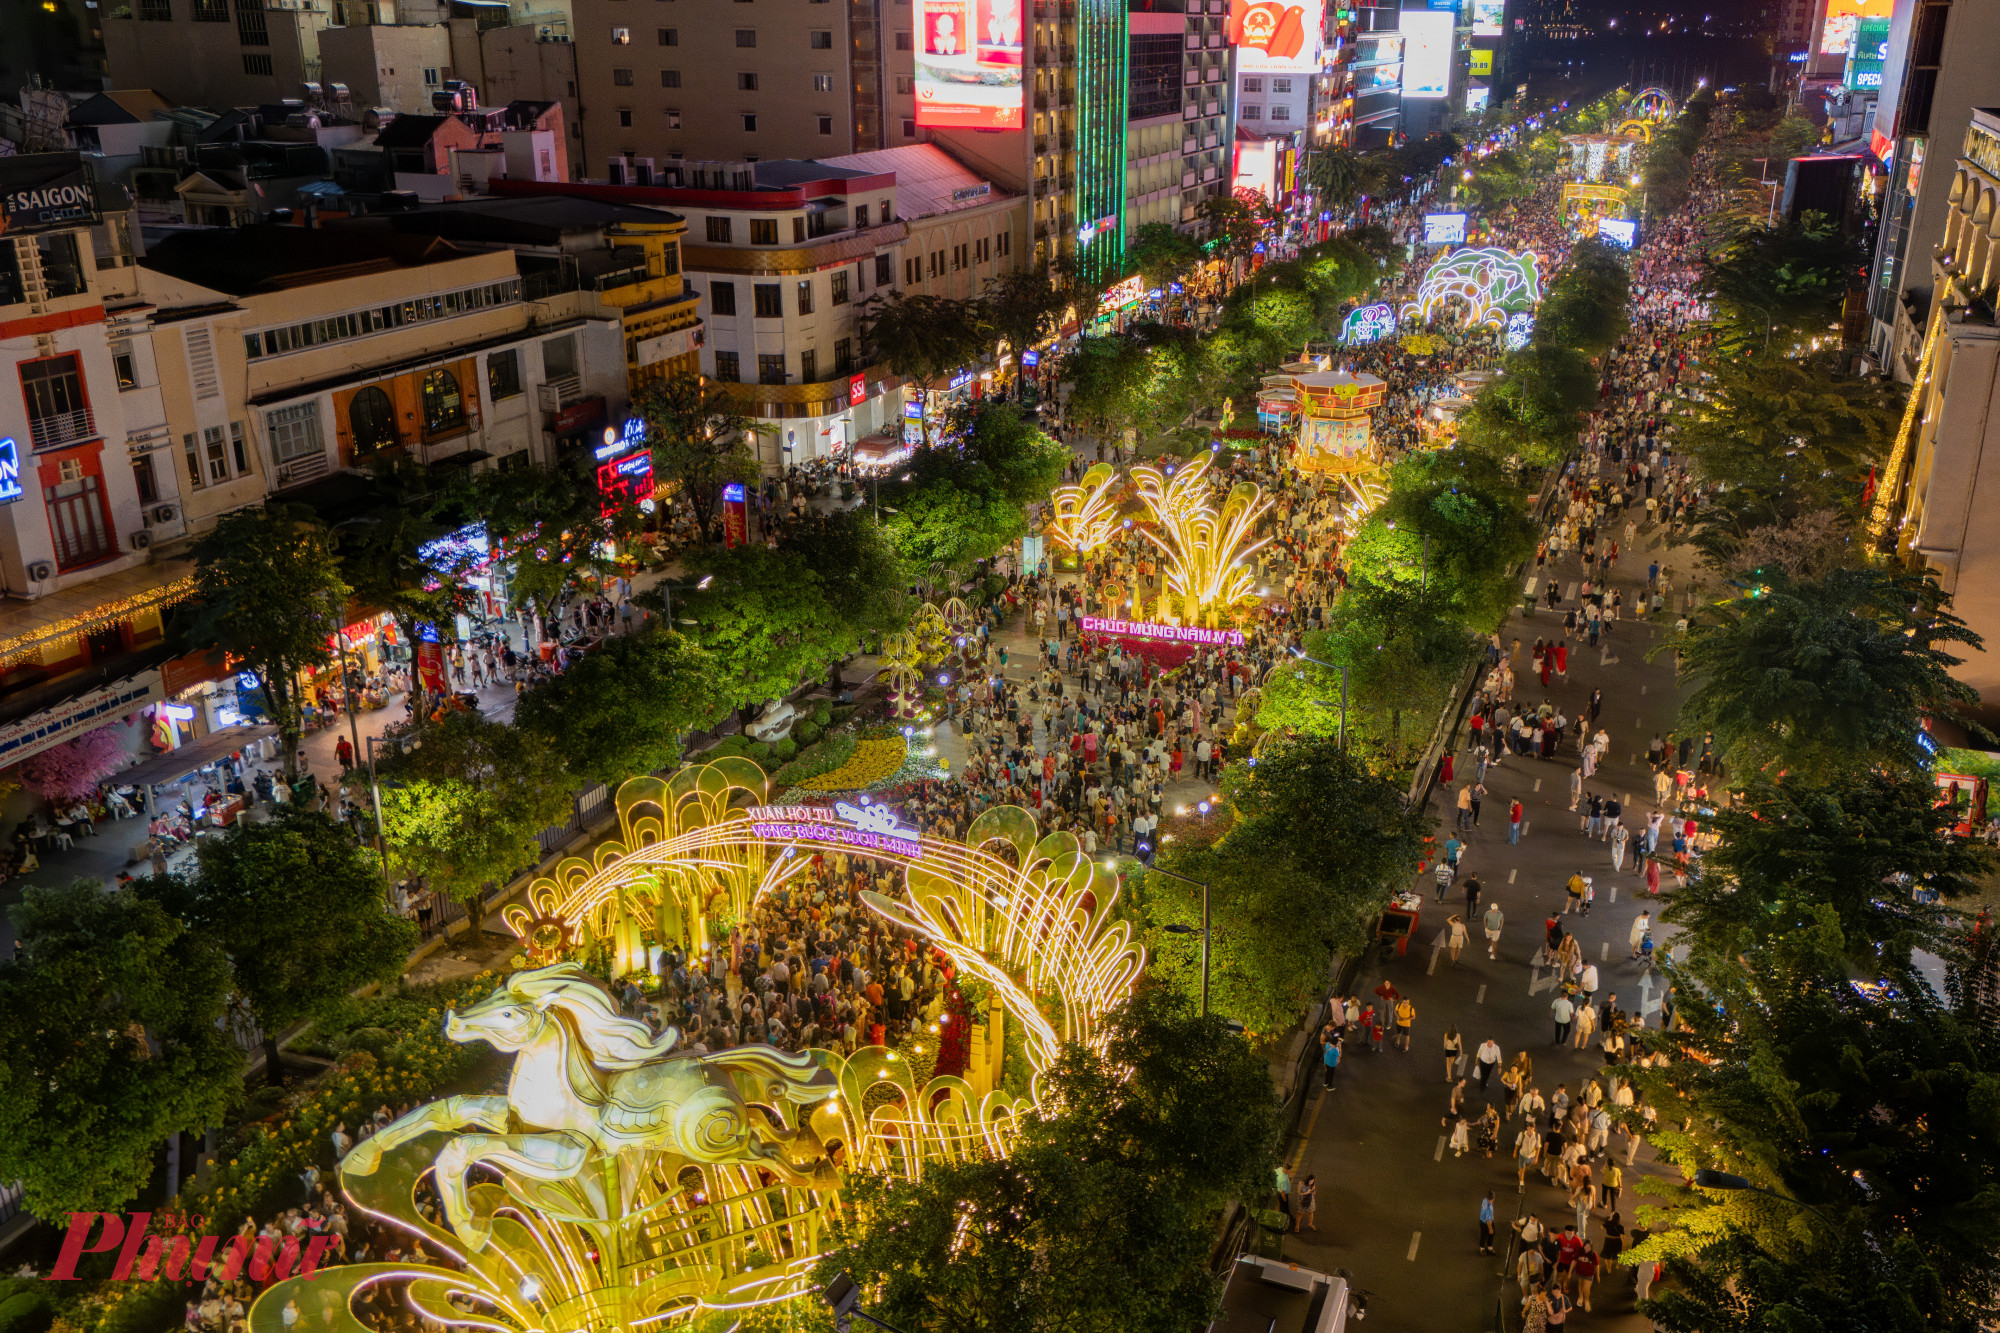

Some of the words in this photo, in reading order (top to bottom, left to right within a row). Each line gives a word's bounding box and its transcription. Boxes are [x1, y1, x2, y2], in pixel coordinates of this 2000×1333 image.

[17, 184, 89, 210] SAIGON
[852, 380, 865, 399] SSI
[1083, 616, 1127, 633] CHÚC
[1129, 619, 1175, 639] MỪNG
[1177, 625, 1212, 643] NĂM
[746, 804, 786, 821] XUÂN
